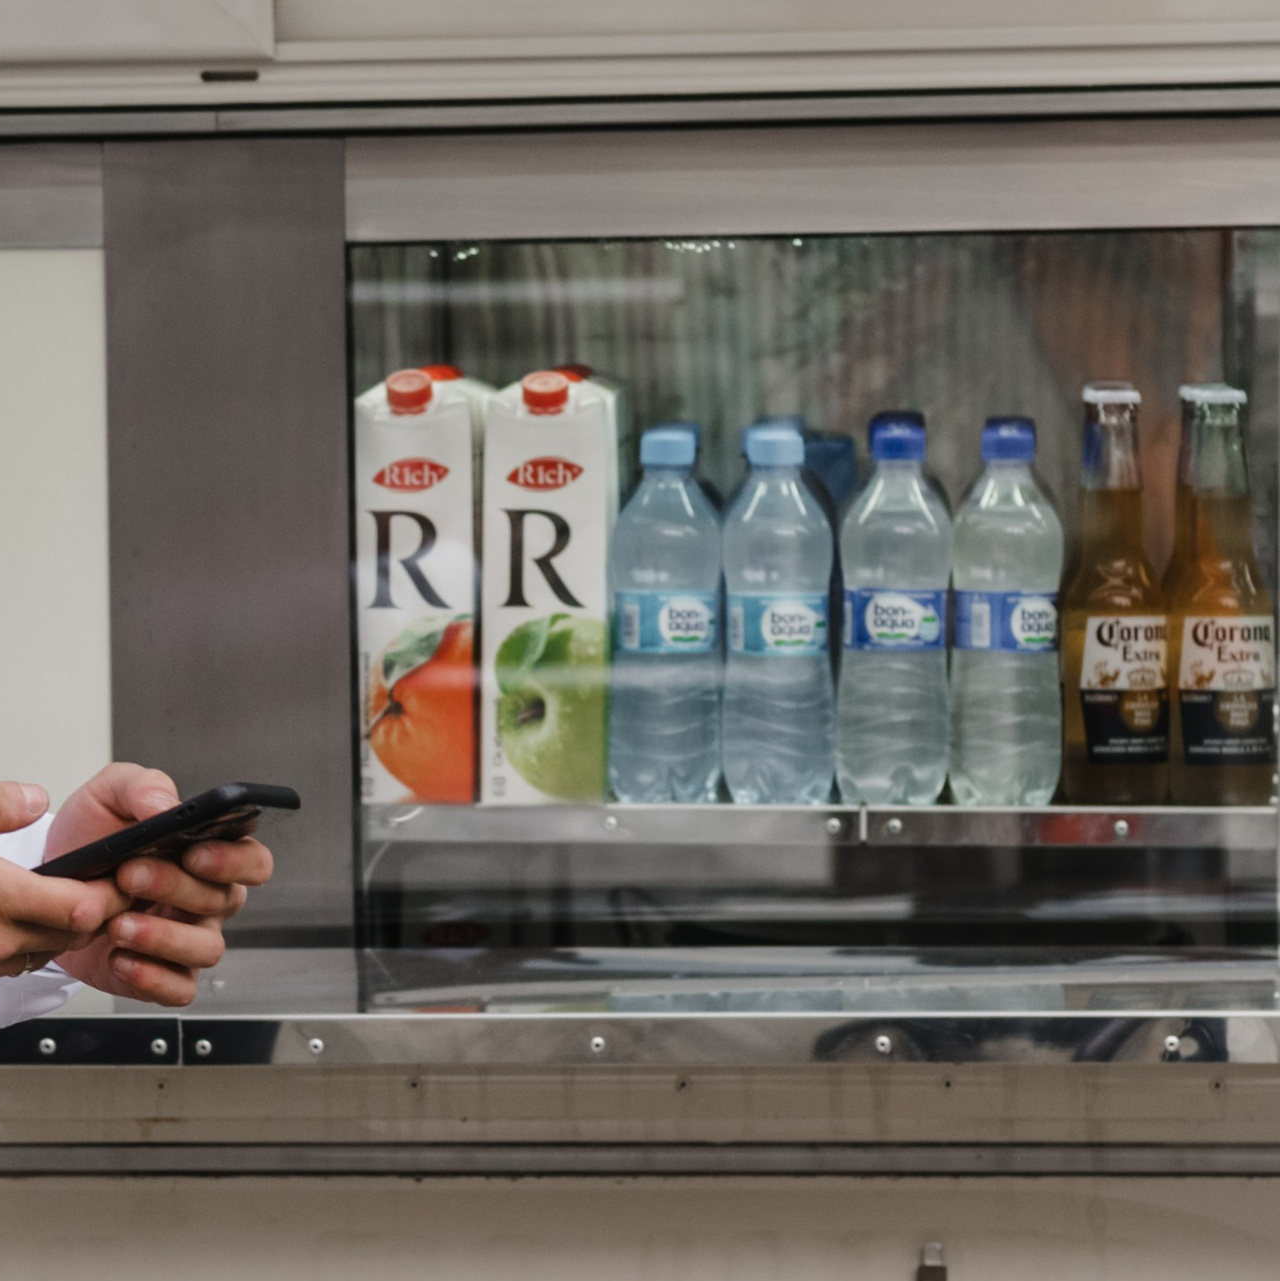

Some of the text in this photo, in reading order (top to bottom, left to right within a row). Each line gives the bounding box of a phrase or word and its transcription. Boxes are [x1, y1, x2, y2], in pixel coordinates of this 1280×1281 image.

[384, 464, 438, 486] Rich
[517, 463, 571, 485] Rich
[367, 510, 451, 609] R
[500, 509, 586, 608] R
